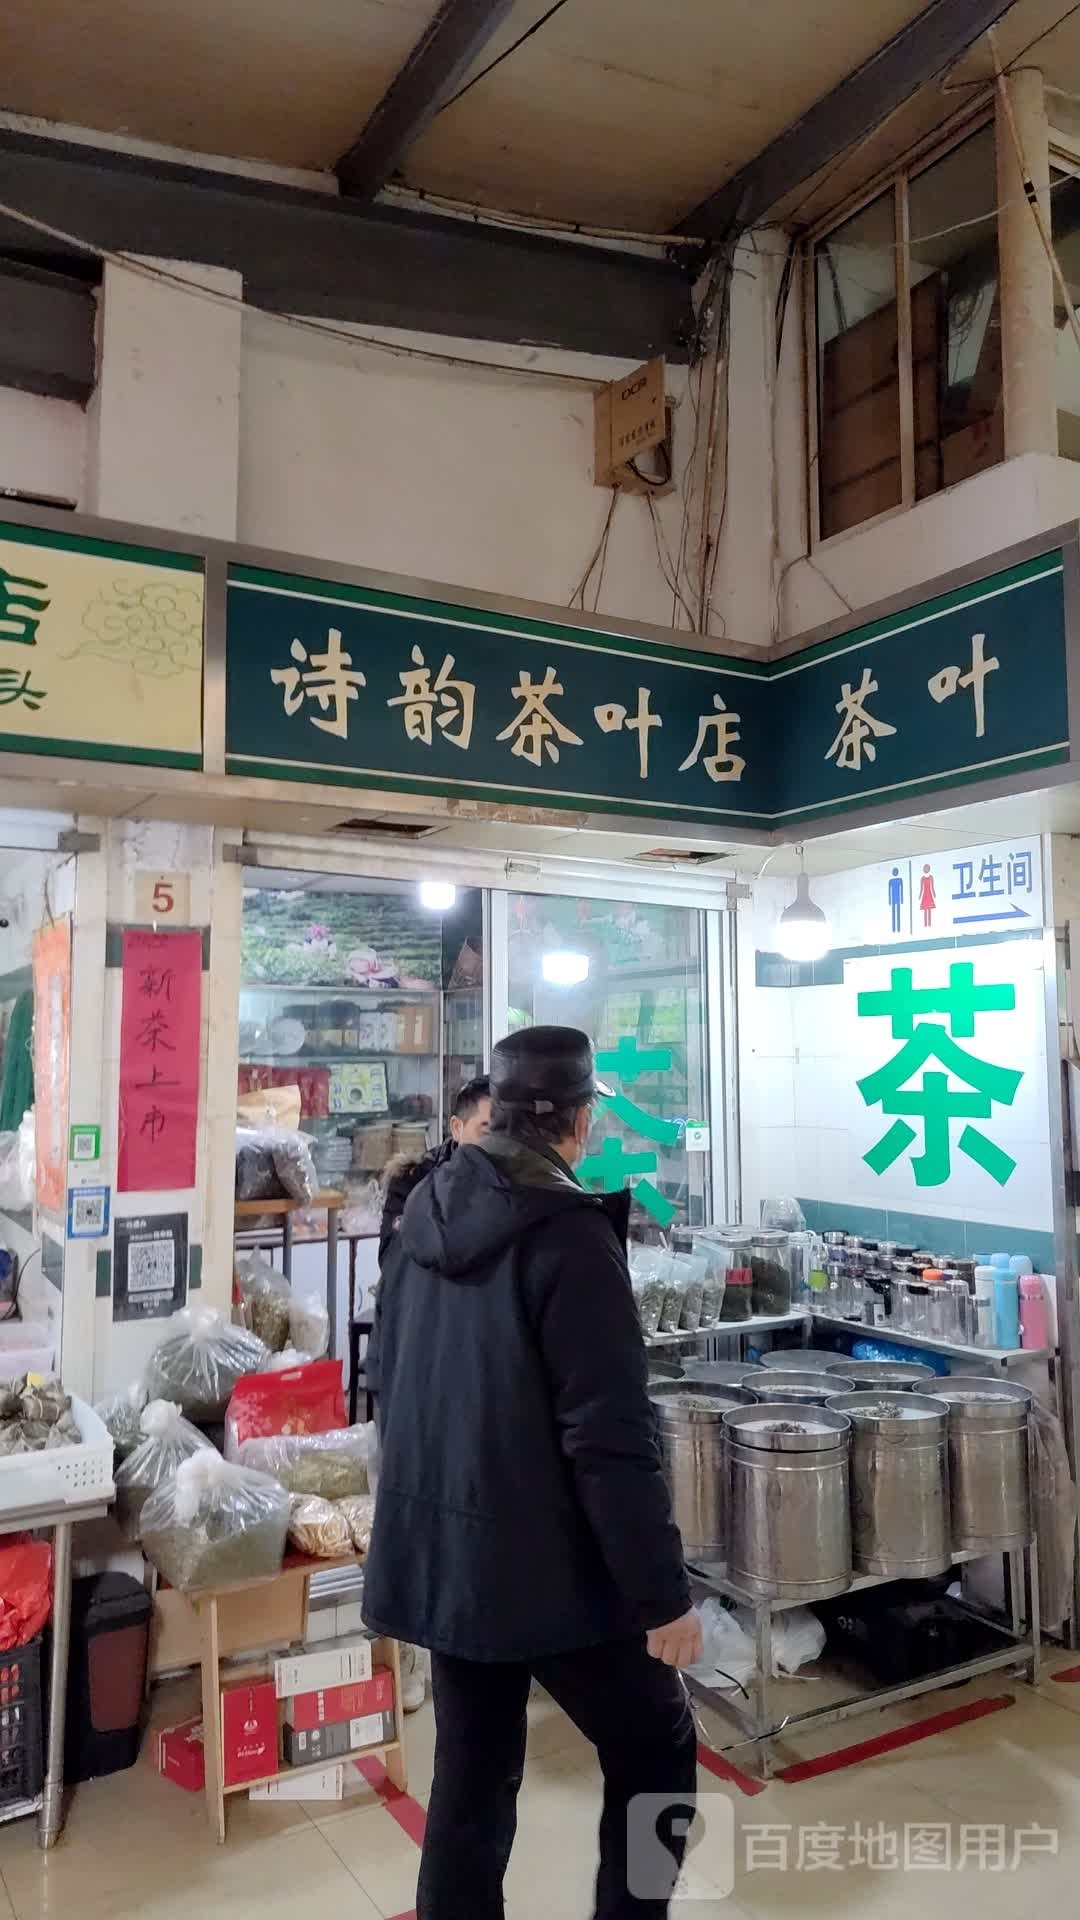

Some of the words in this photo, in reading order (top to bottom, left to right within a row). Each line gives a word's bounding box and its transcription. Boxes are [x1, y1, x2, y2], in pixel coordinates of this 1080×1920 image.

[270, 627, 747, 784] 诗韵茶叶店
[824, 633, 1000, 771] 茶叶
[152, 883, 175, 913] 5
[951, 850, 1033, 901] 卫生间
[134, 964, 181, 1145] 新茶上市
[856, 961, 1025, 1188] 茶
